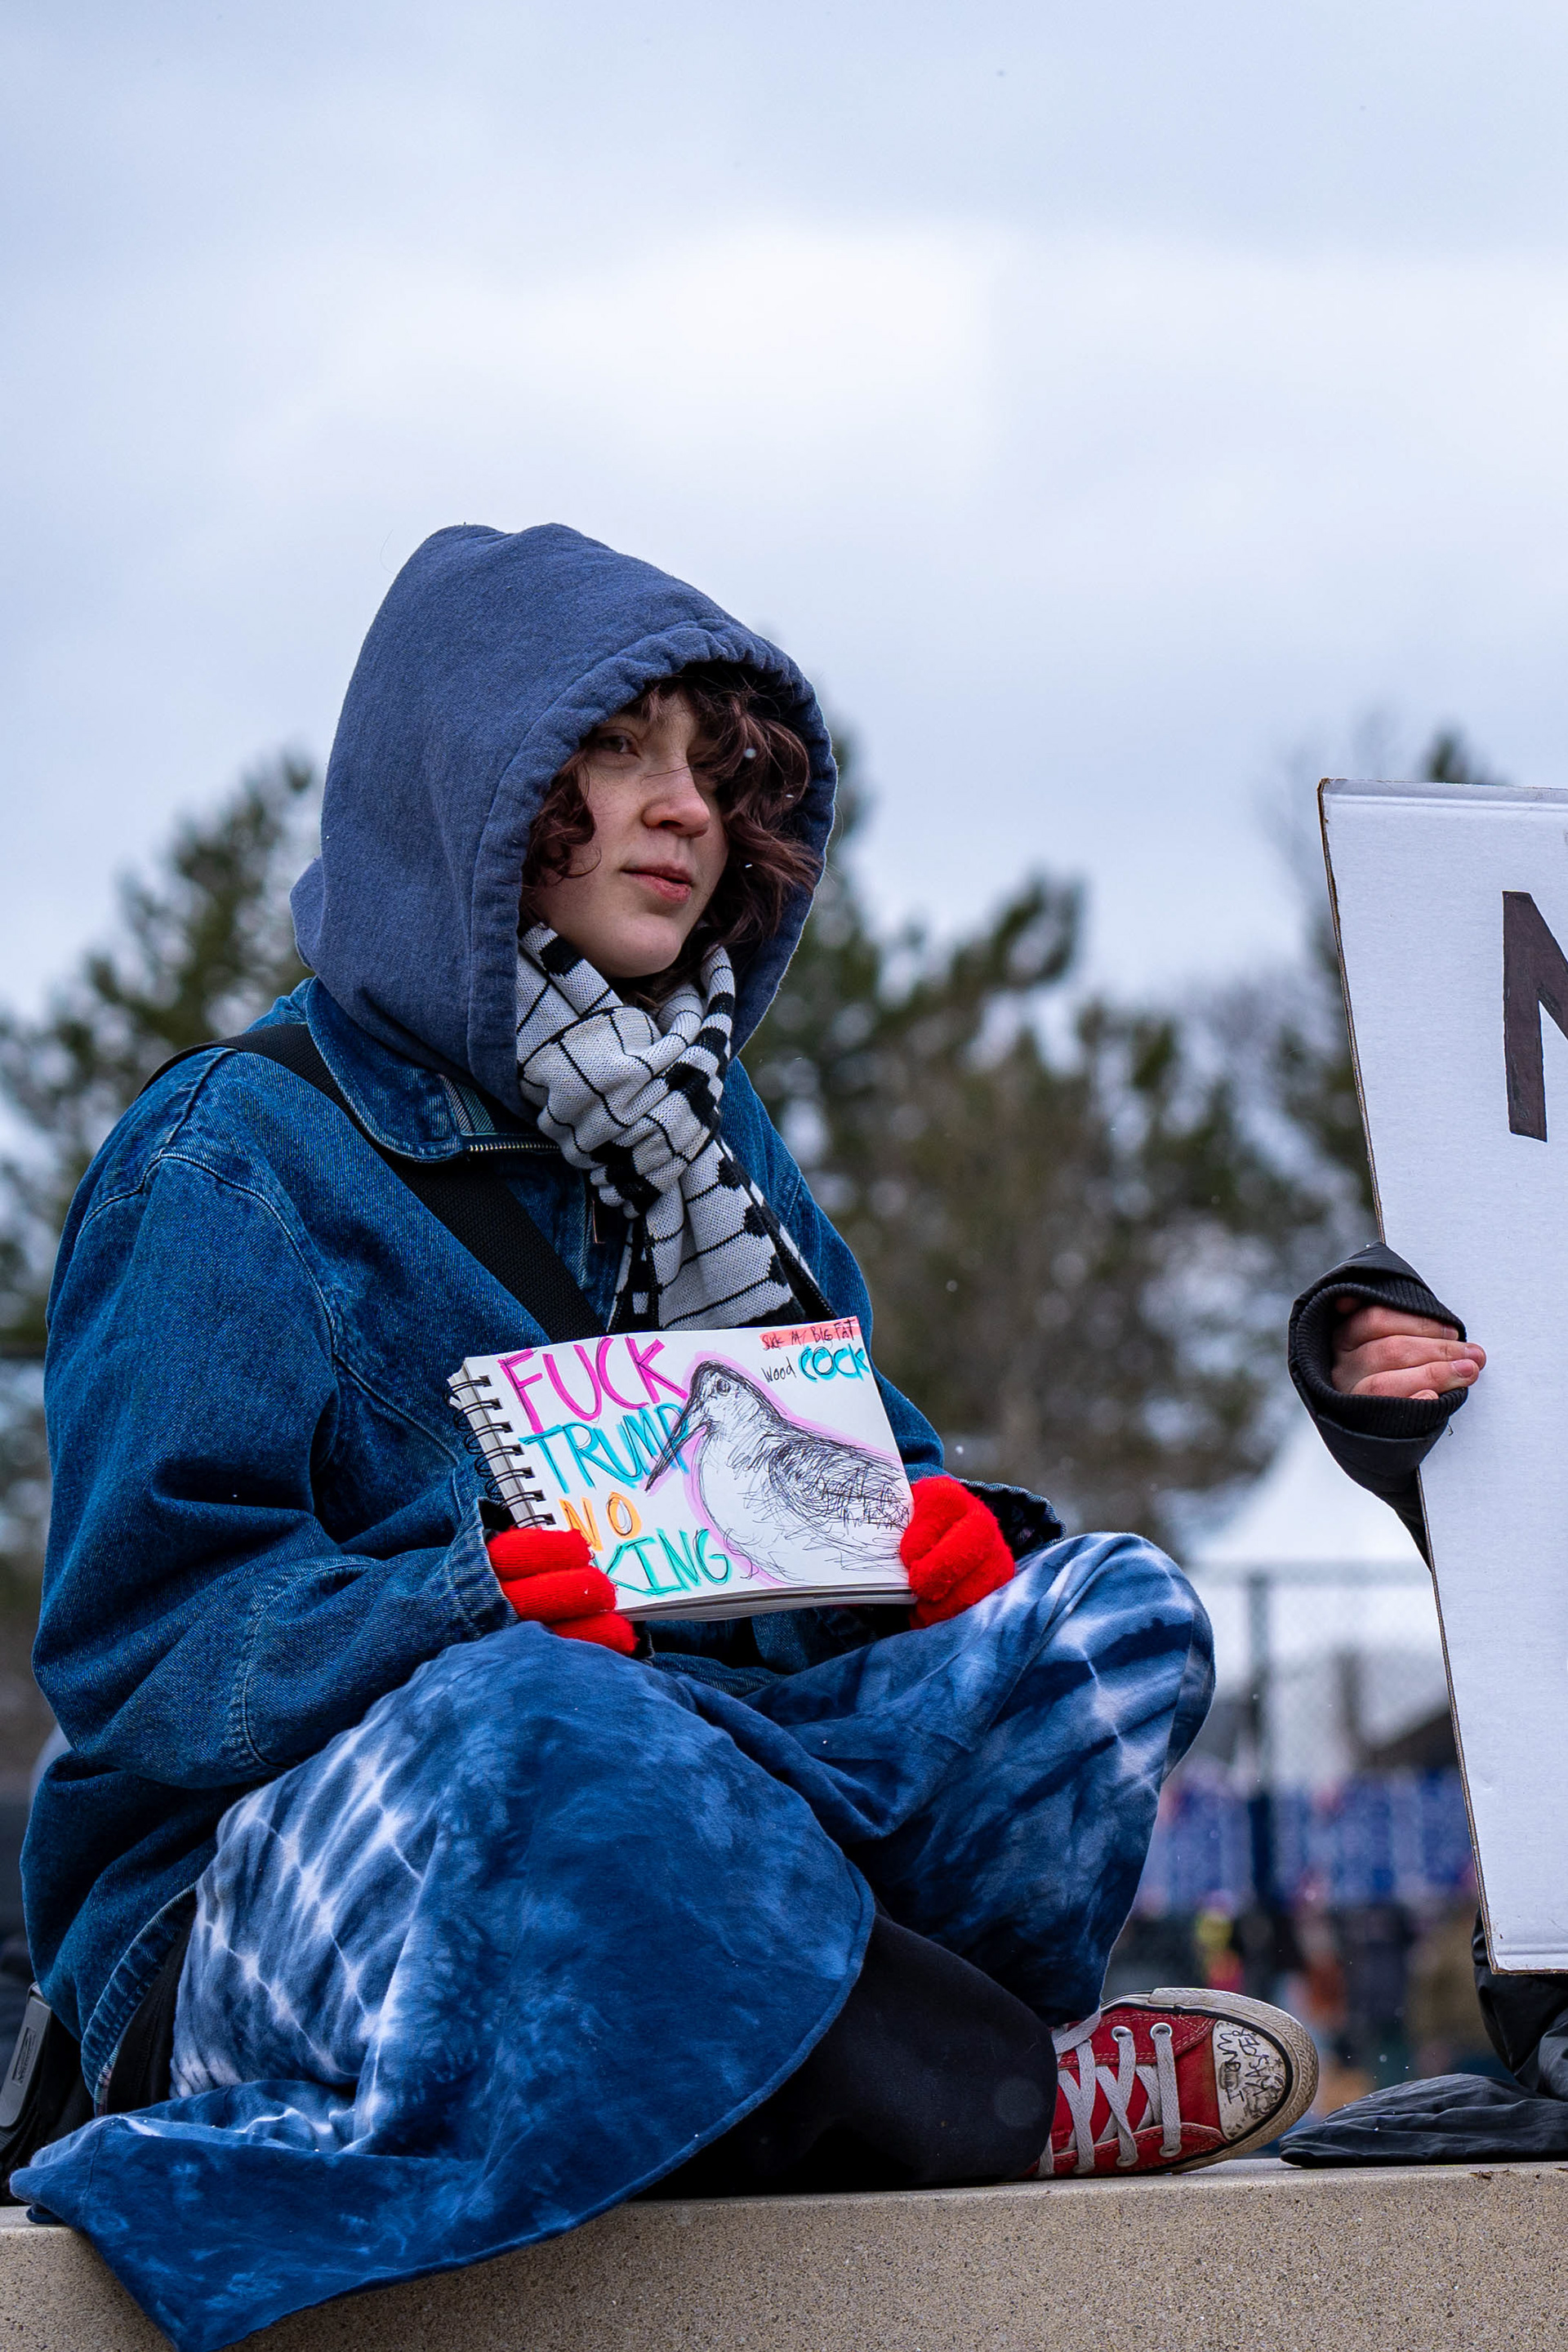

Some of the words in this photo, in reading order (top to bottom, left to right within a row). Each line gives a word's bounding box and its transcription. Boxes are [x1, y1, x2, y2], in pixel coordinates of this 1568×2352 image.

[497, 1335, 688, 1434] FUCK
[518, 1403, 689, 1494] TRUMP
[559, 1491, 643, 1551] NO
[591, 1527, 733, 1597] KING
